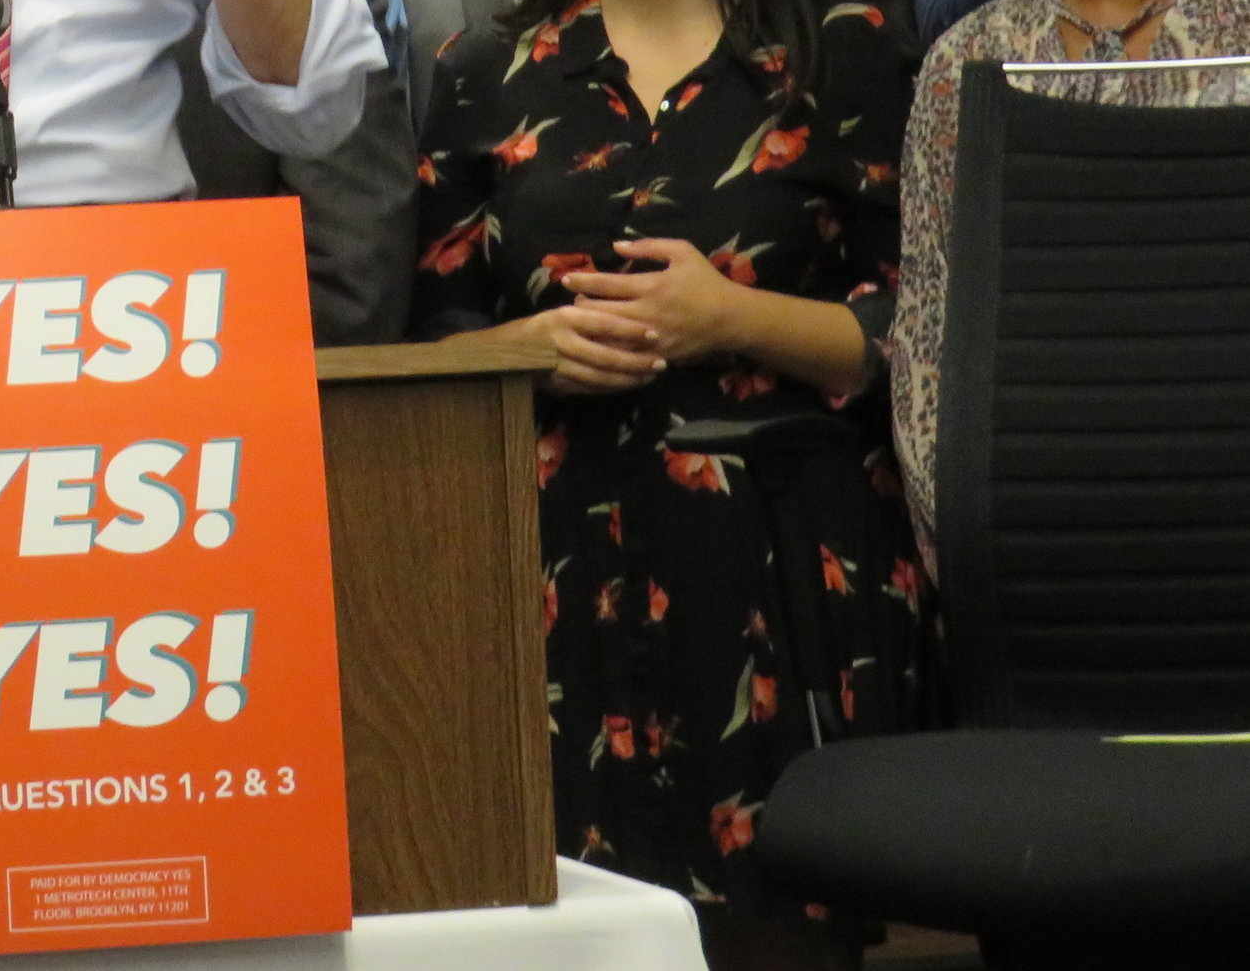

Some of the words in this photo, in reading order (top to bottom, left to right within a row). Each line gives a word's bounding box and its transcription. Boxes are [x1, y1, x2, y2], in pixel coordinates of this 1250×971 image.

[30, 876, 56, 890] PAID
[59, 874, 81, 888] FOR
[83, 874, 97, 886] BY
[100, 869, 168, 886] DEMOCRACY
[172, 868, 191, 881] YES
[36, 894, 41, 905] 1
[44, 889, 111, 905] METROTECH
[161, 884, 188, 897] 11TH
[138, 900, 154, 913] NY
[158, 899, 190, 913] 11201
